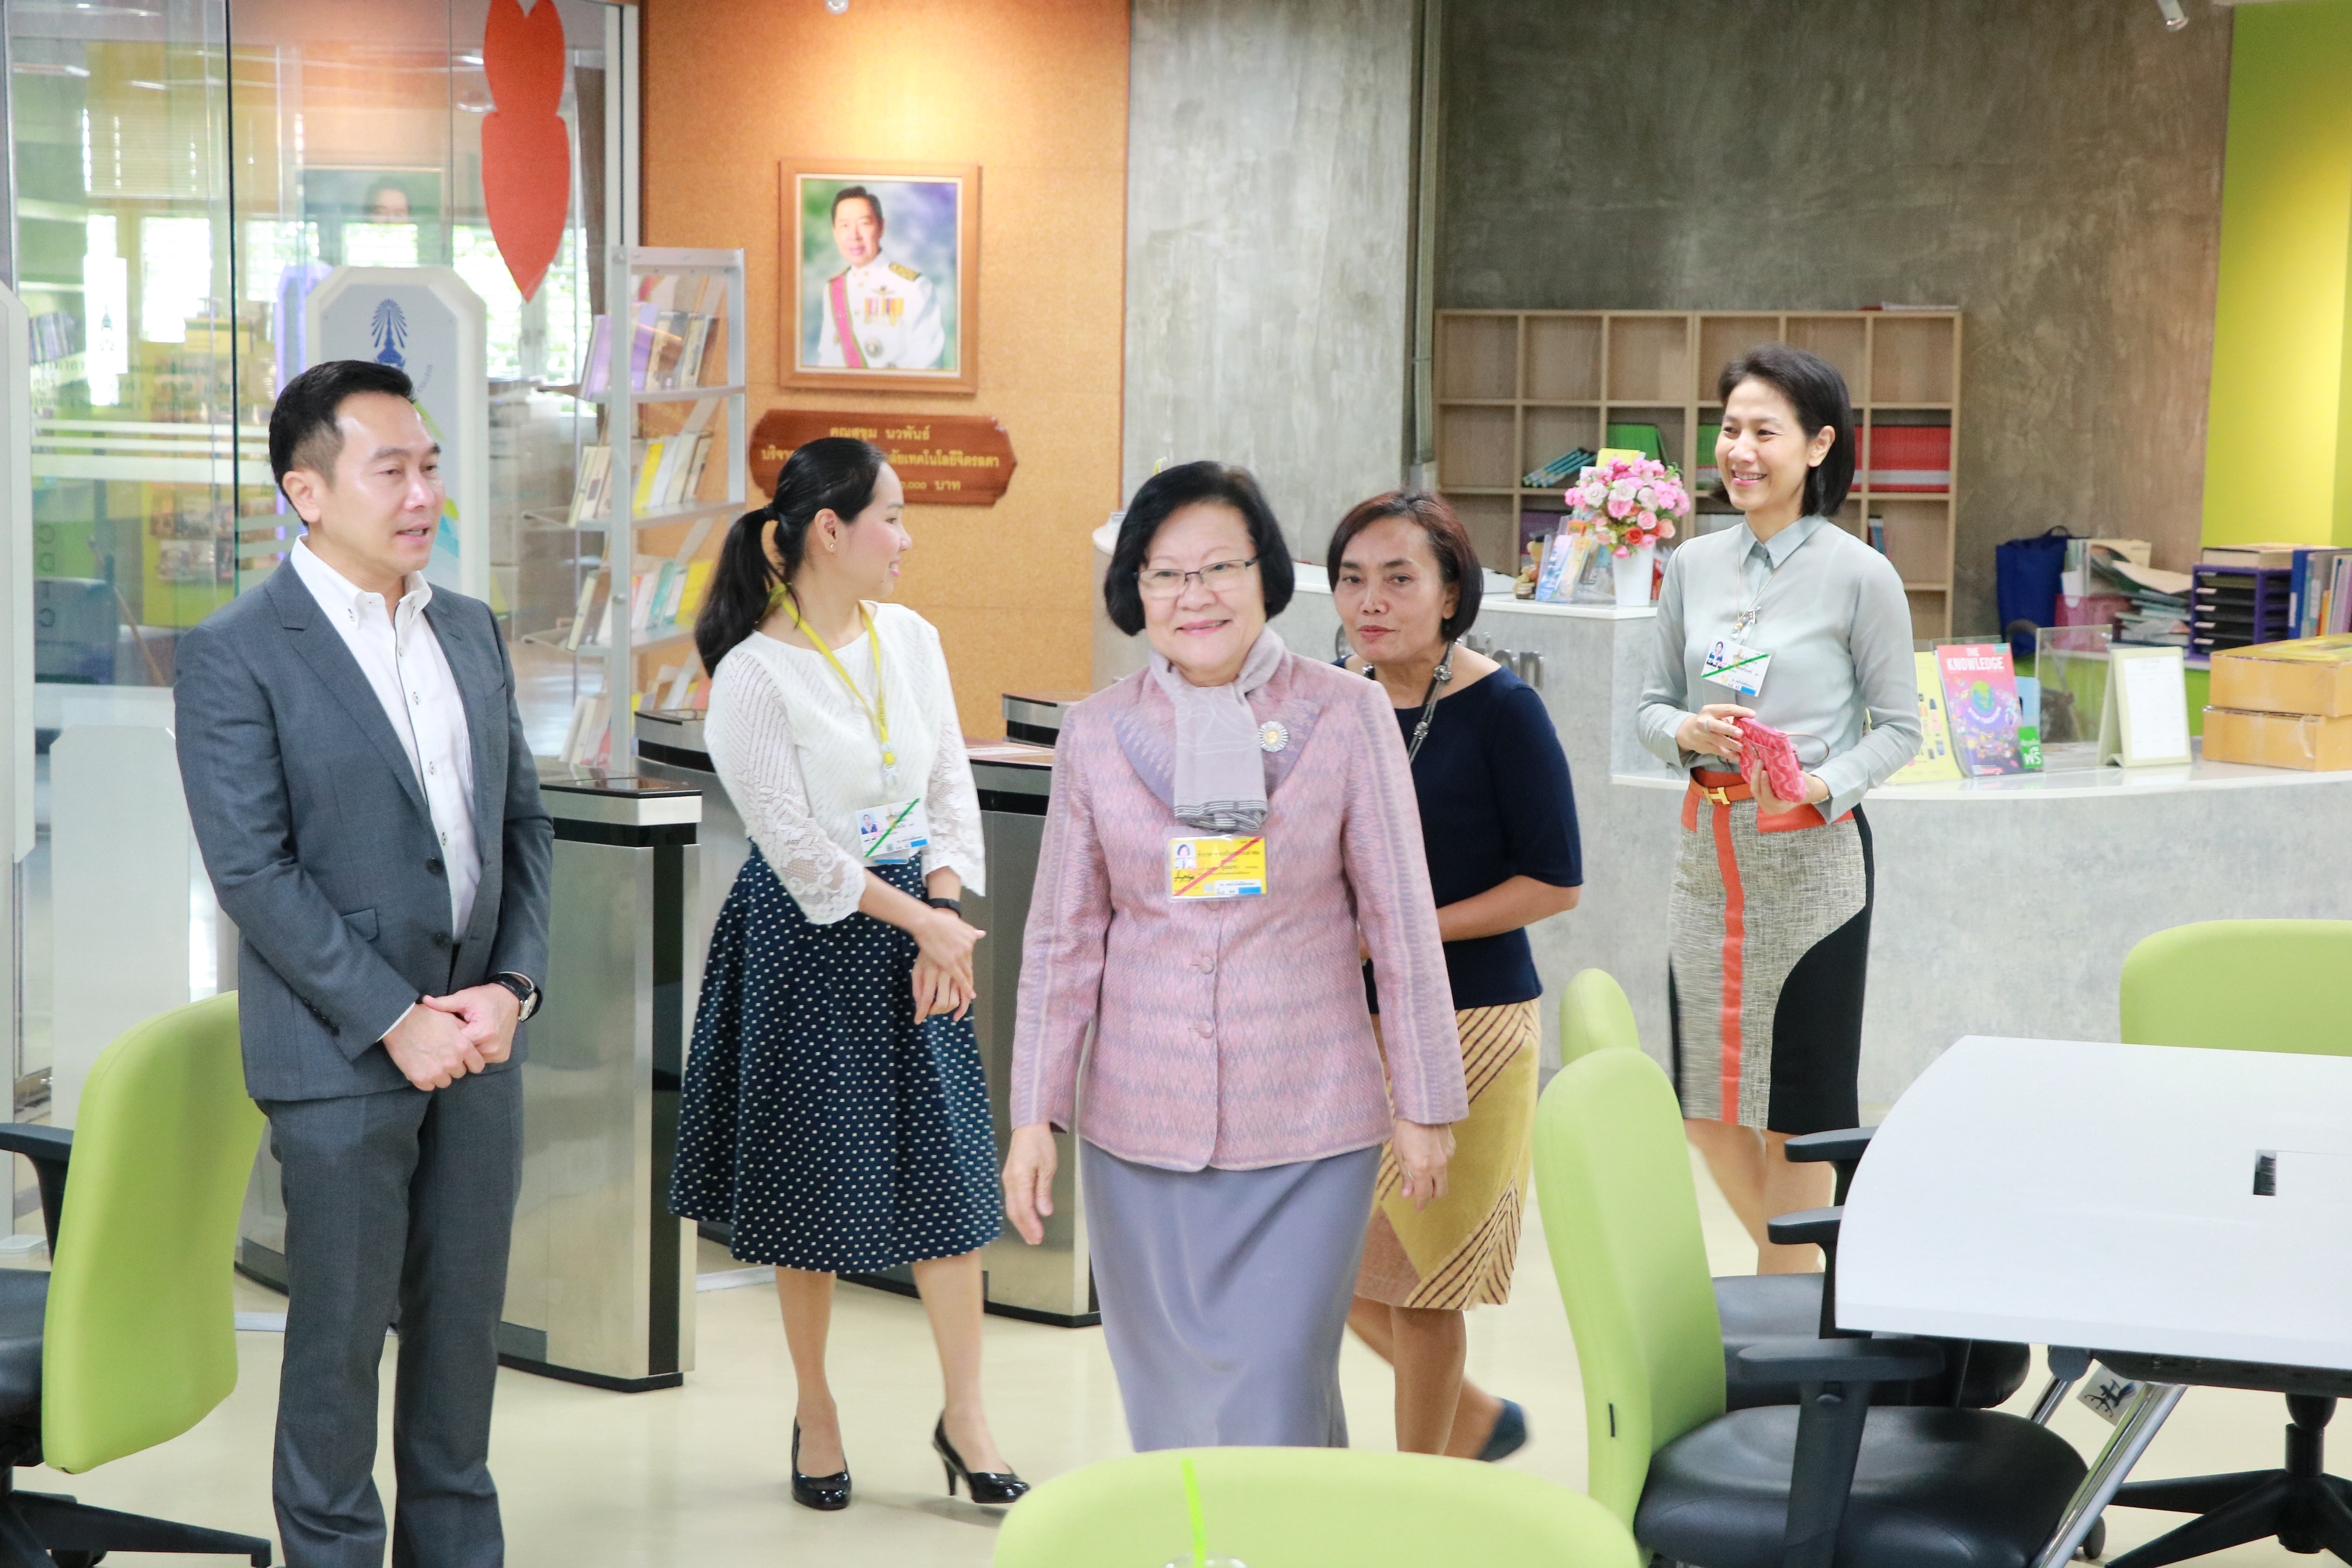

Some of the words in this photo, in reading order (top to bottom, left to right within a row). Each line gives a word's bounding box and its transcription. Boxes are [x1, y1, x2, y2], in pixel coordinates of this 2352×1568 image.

[935, 480, 961, 490] บาท
[1965, 647, 1980, 656] THE
[1946, 656, 2005, 671] KNOWLEDGE
